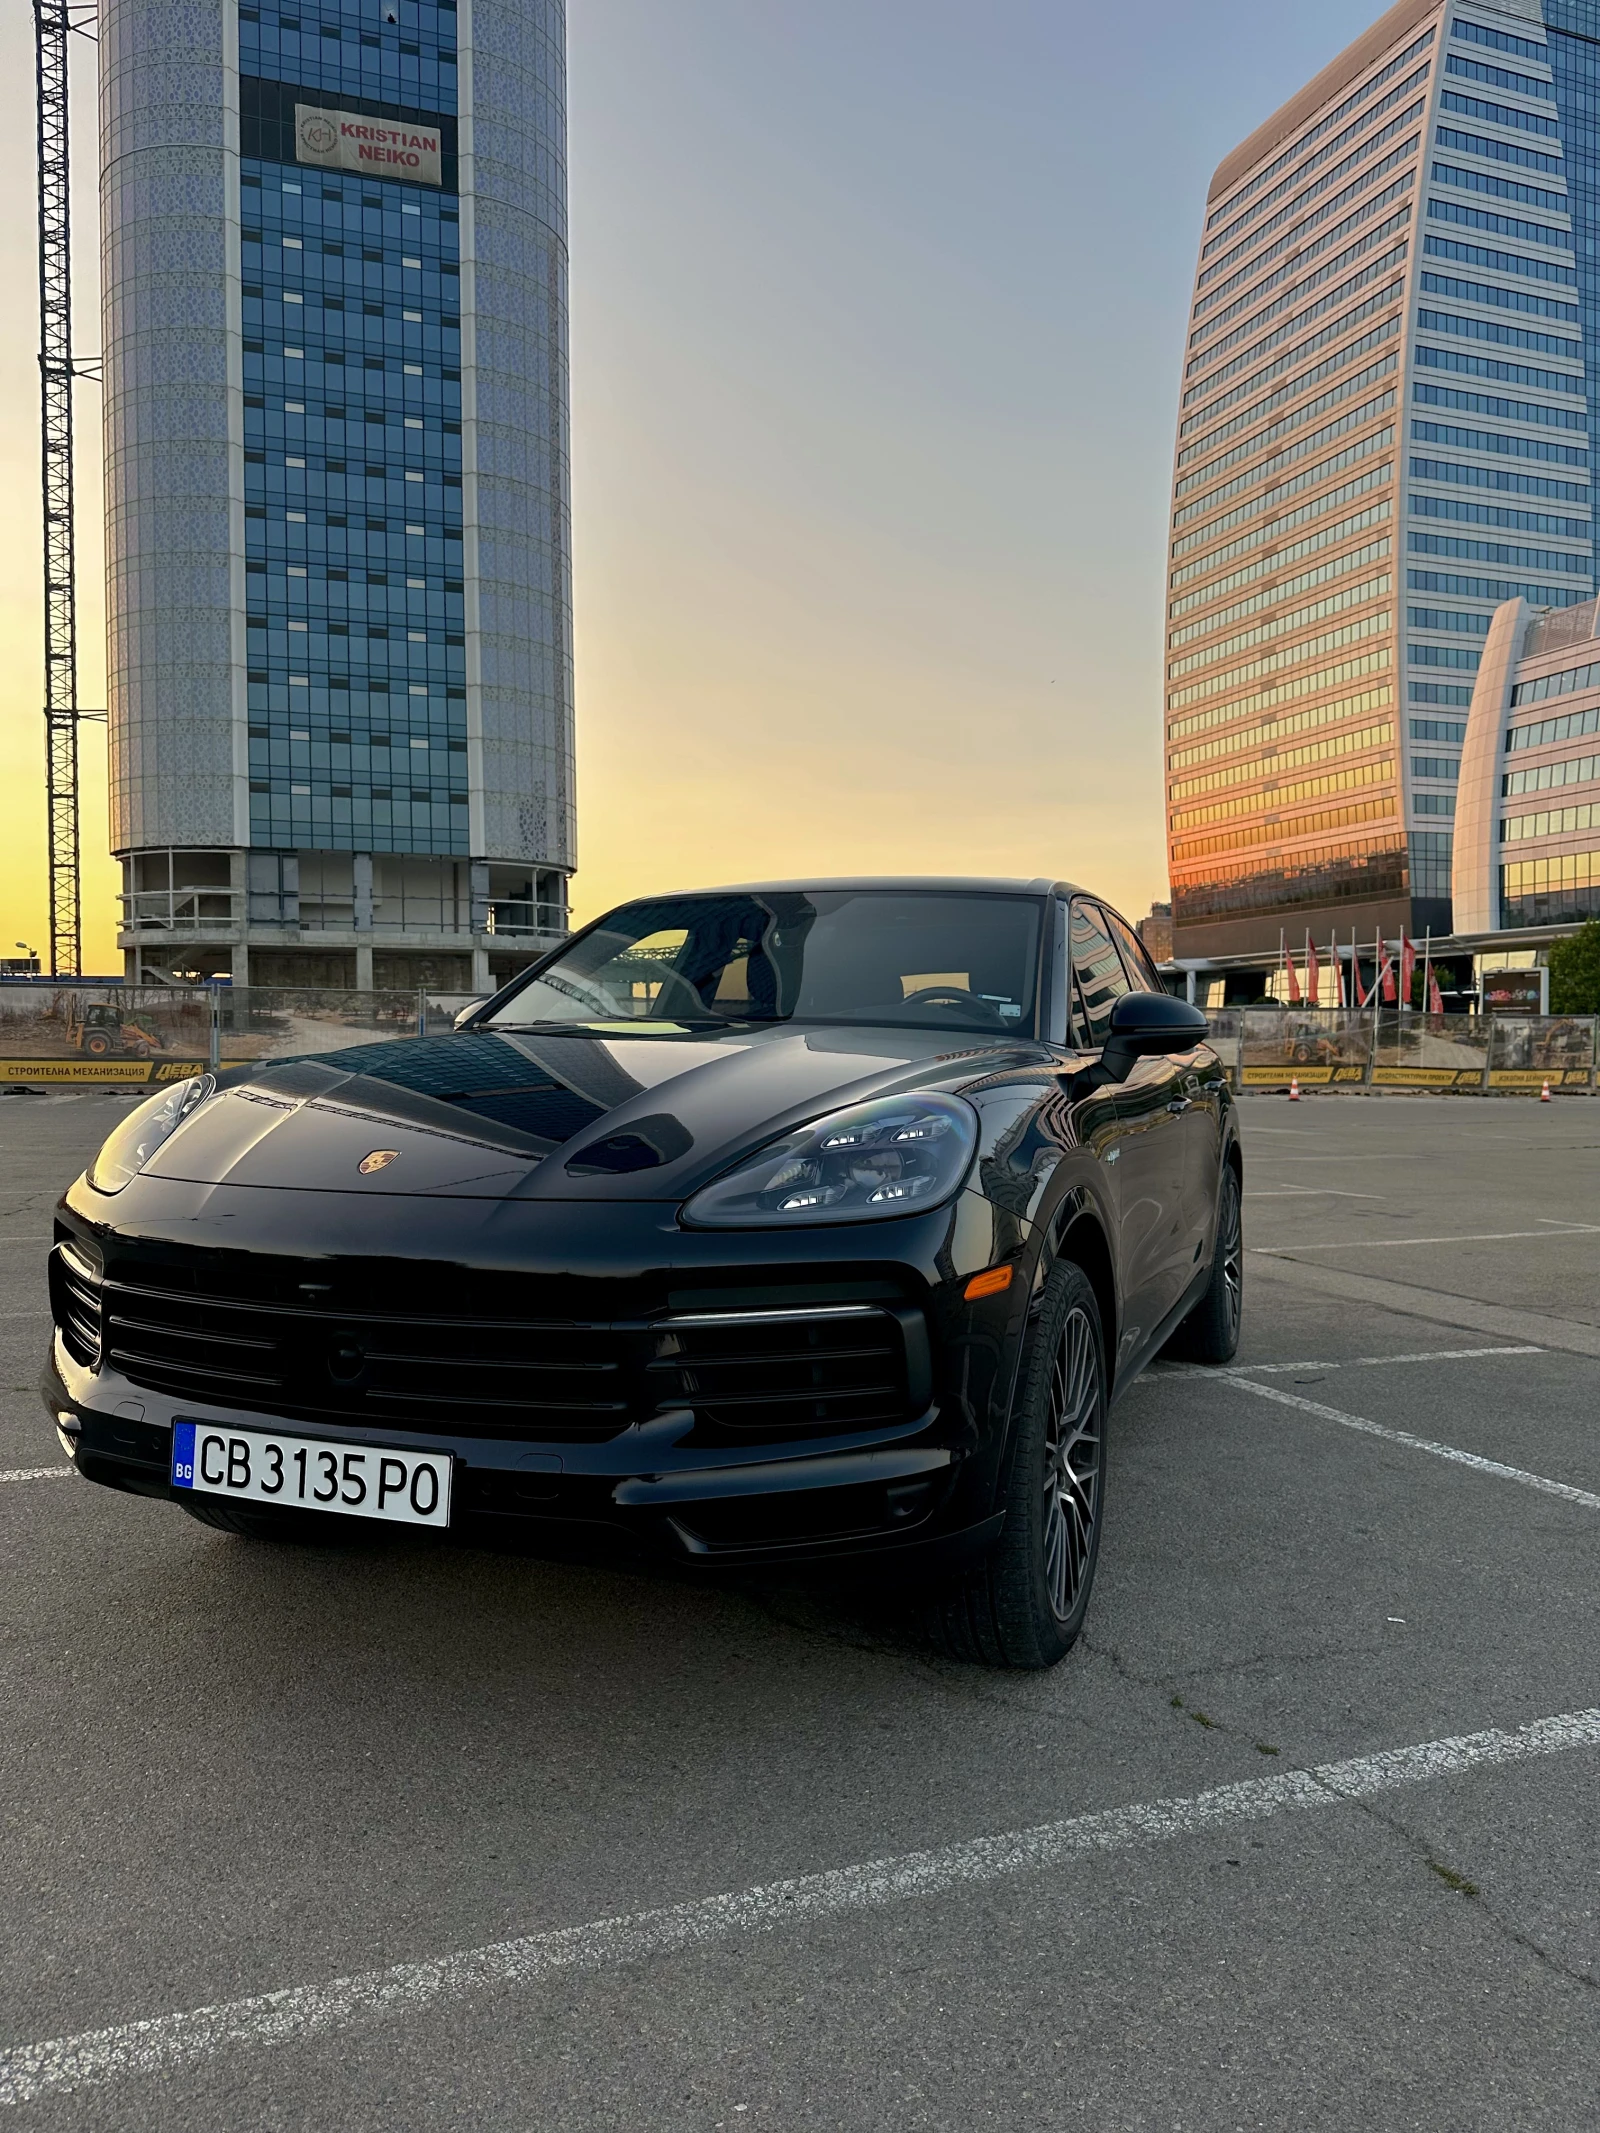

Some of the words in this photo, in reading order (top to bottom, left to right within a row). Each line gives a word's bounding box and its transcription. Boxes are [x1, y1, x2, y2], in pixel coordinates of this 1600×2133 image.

[340, 122, 437, 153] KRISTIAN
[358, 144, 420, 168] NEIKO
[8, 1066, 71, 1076] СТРОИТЕЛНА
[73, 1067, 145, 1077] МЕХАНИЗАЦИЯ
[155, 1063, 203, 1081] ДЕВА
[176, 1462, 192, 1480] BG
[260, 1443, 367, 1505] 3135
